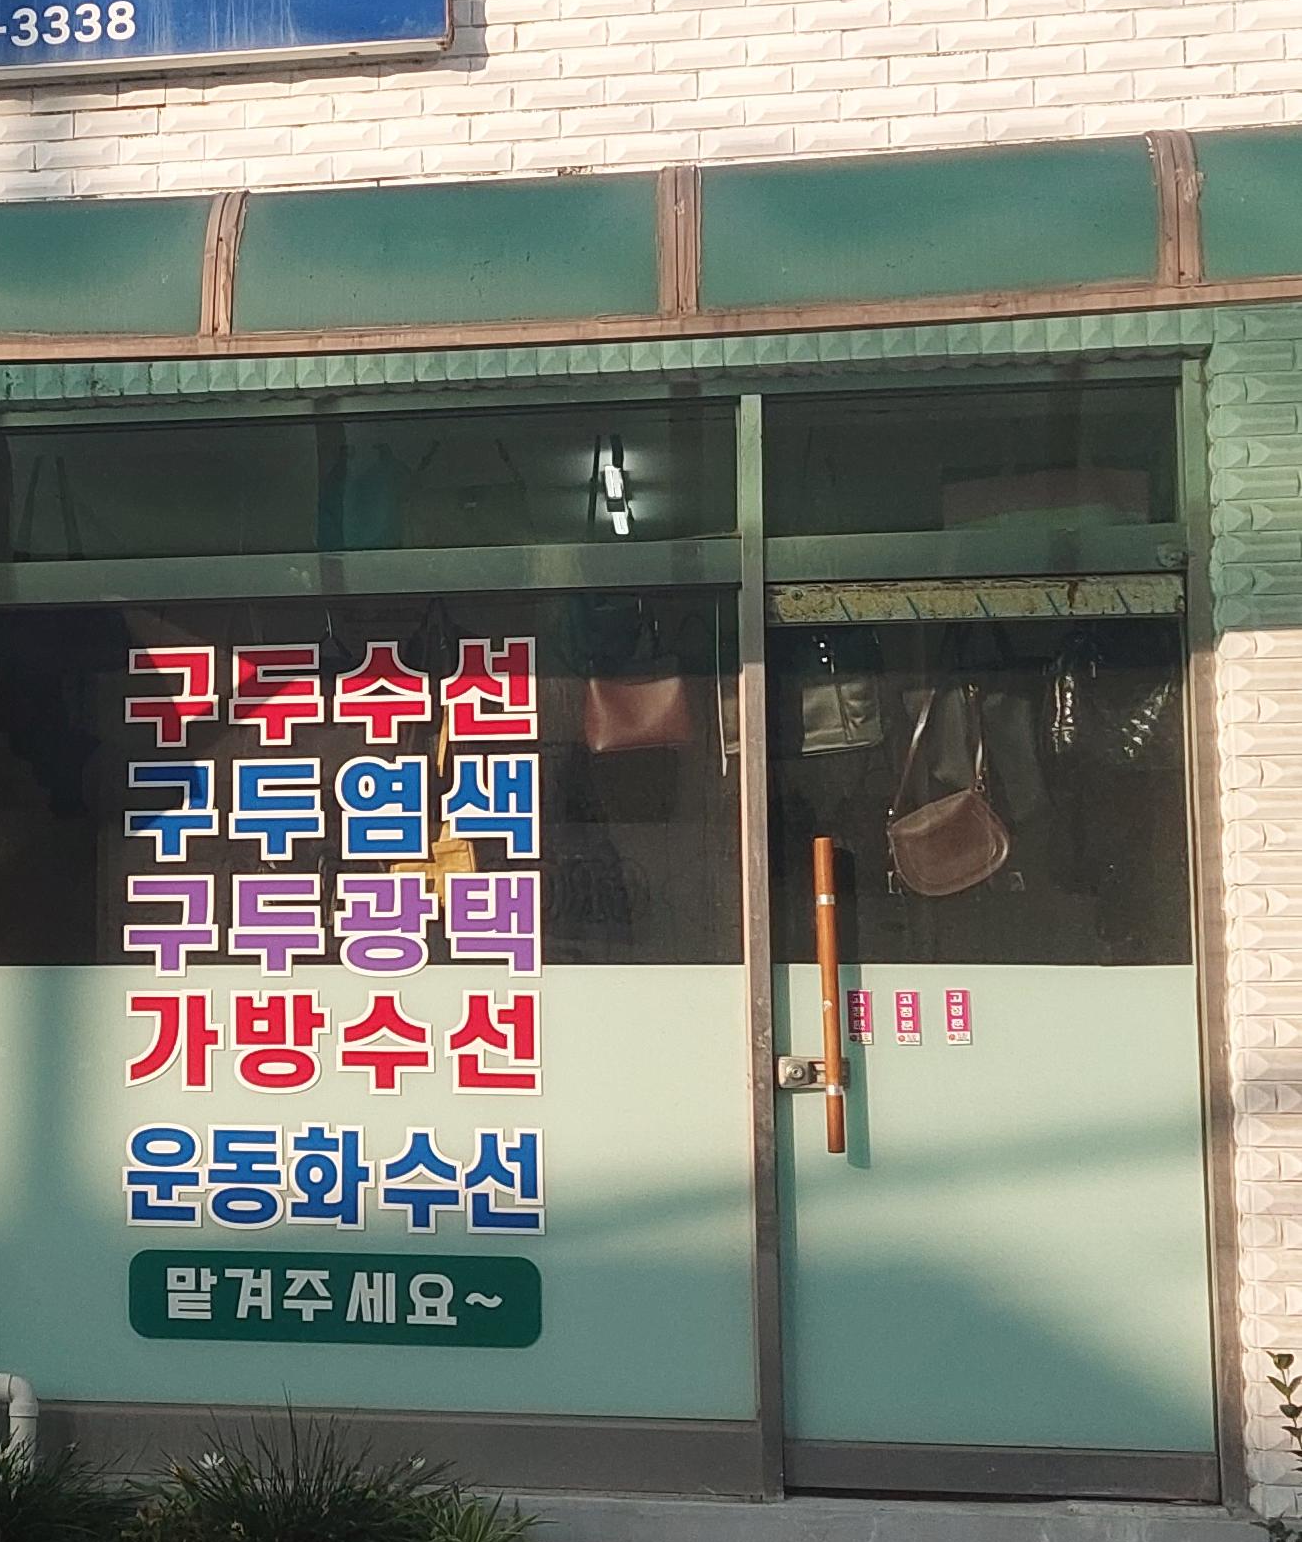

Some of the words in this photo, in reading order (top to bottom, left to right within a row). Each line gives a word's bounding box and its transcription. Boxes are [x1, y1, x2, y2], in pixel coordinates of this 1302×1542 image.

[125, 637, 538, 747] 구두수선
[125, 754, 540, 861] 구두염색
[124, 871, 542, 977] 구두광택
[125, 989, 543, 1095] 가방수선
[123, 1123, 545, 1234] 운동화수선
[166, 1267, 503, 1326] 맡겨주세요~
